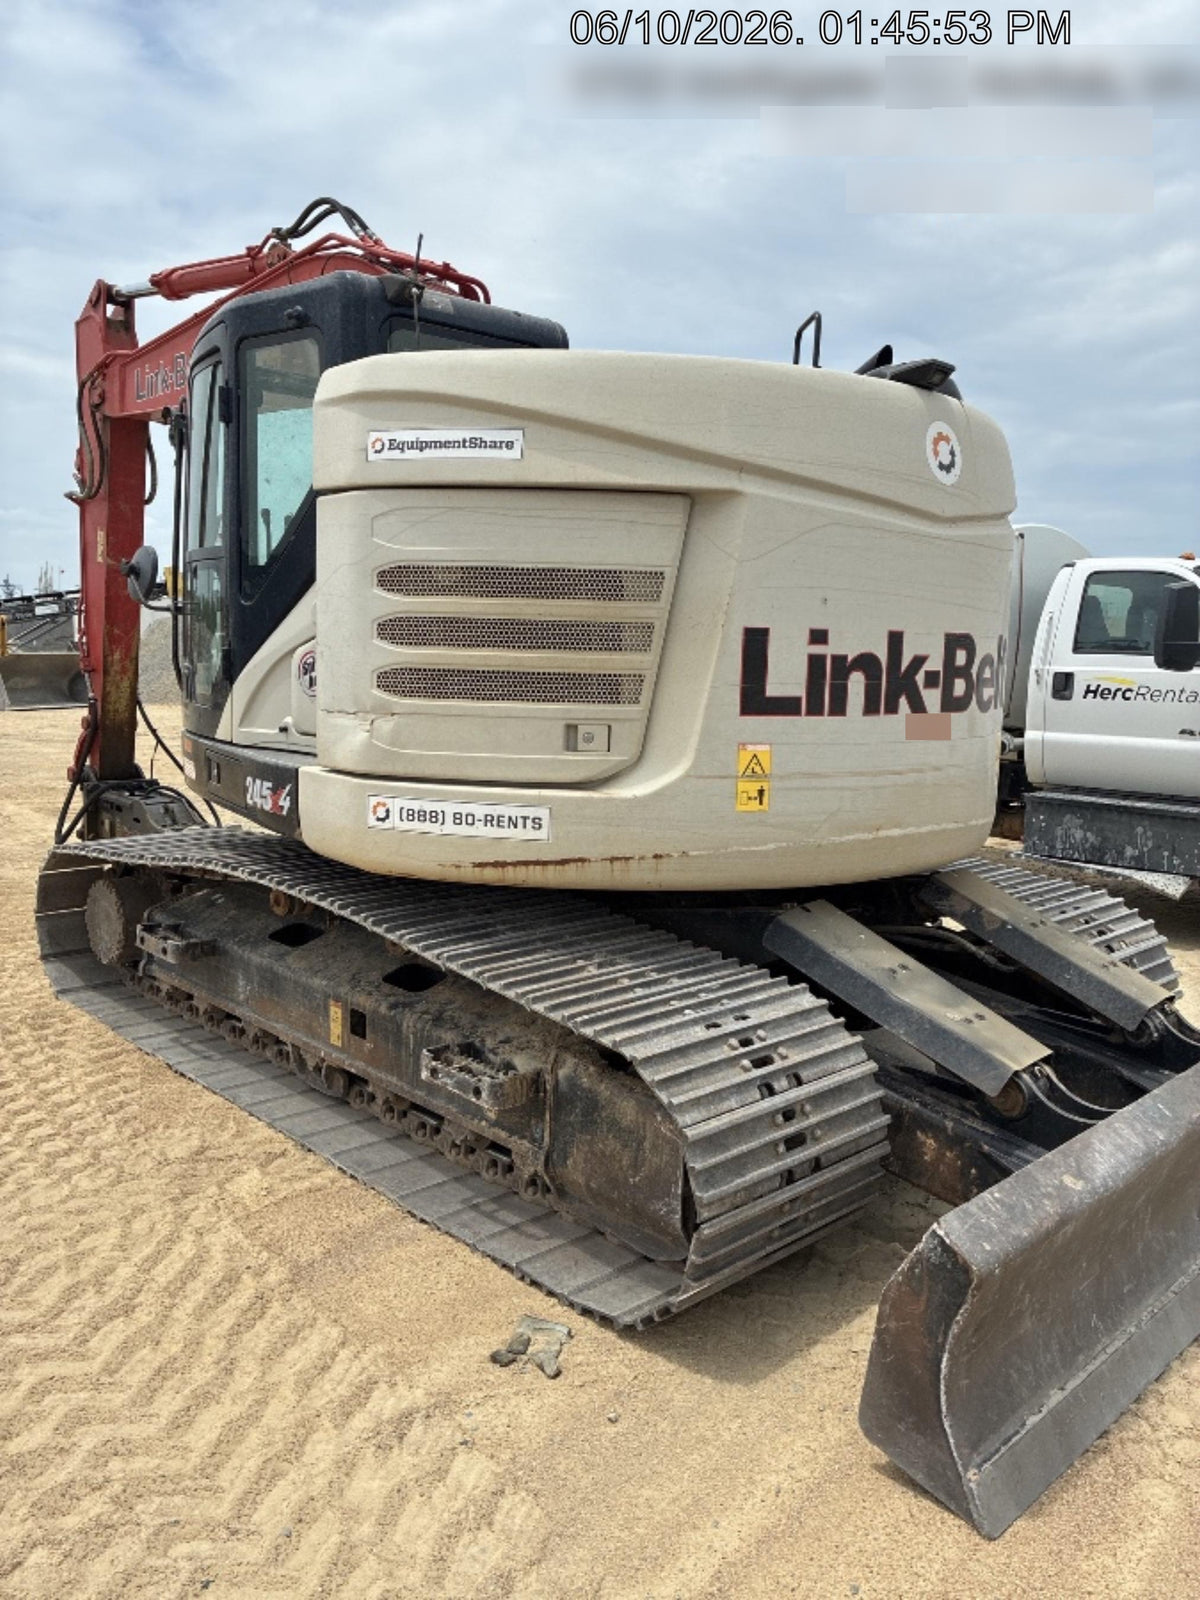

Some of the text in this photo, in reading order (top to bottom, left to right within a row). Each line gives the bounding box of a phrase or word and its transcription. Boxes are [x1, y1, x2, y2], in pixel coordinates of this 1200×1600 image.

[387, 437, 515, 453] EquipmentShare
[1082, 684, 1200, 703] HercRenta
[399, 807, 543, 831] (888) 80-RENTS
